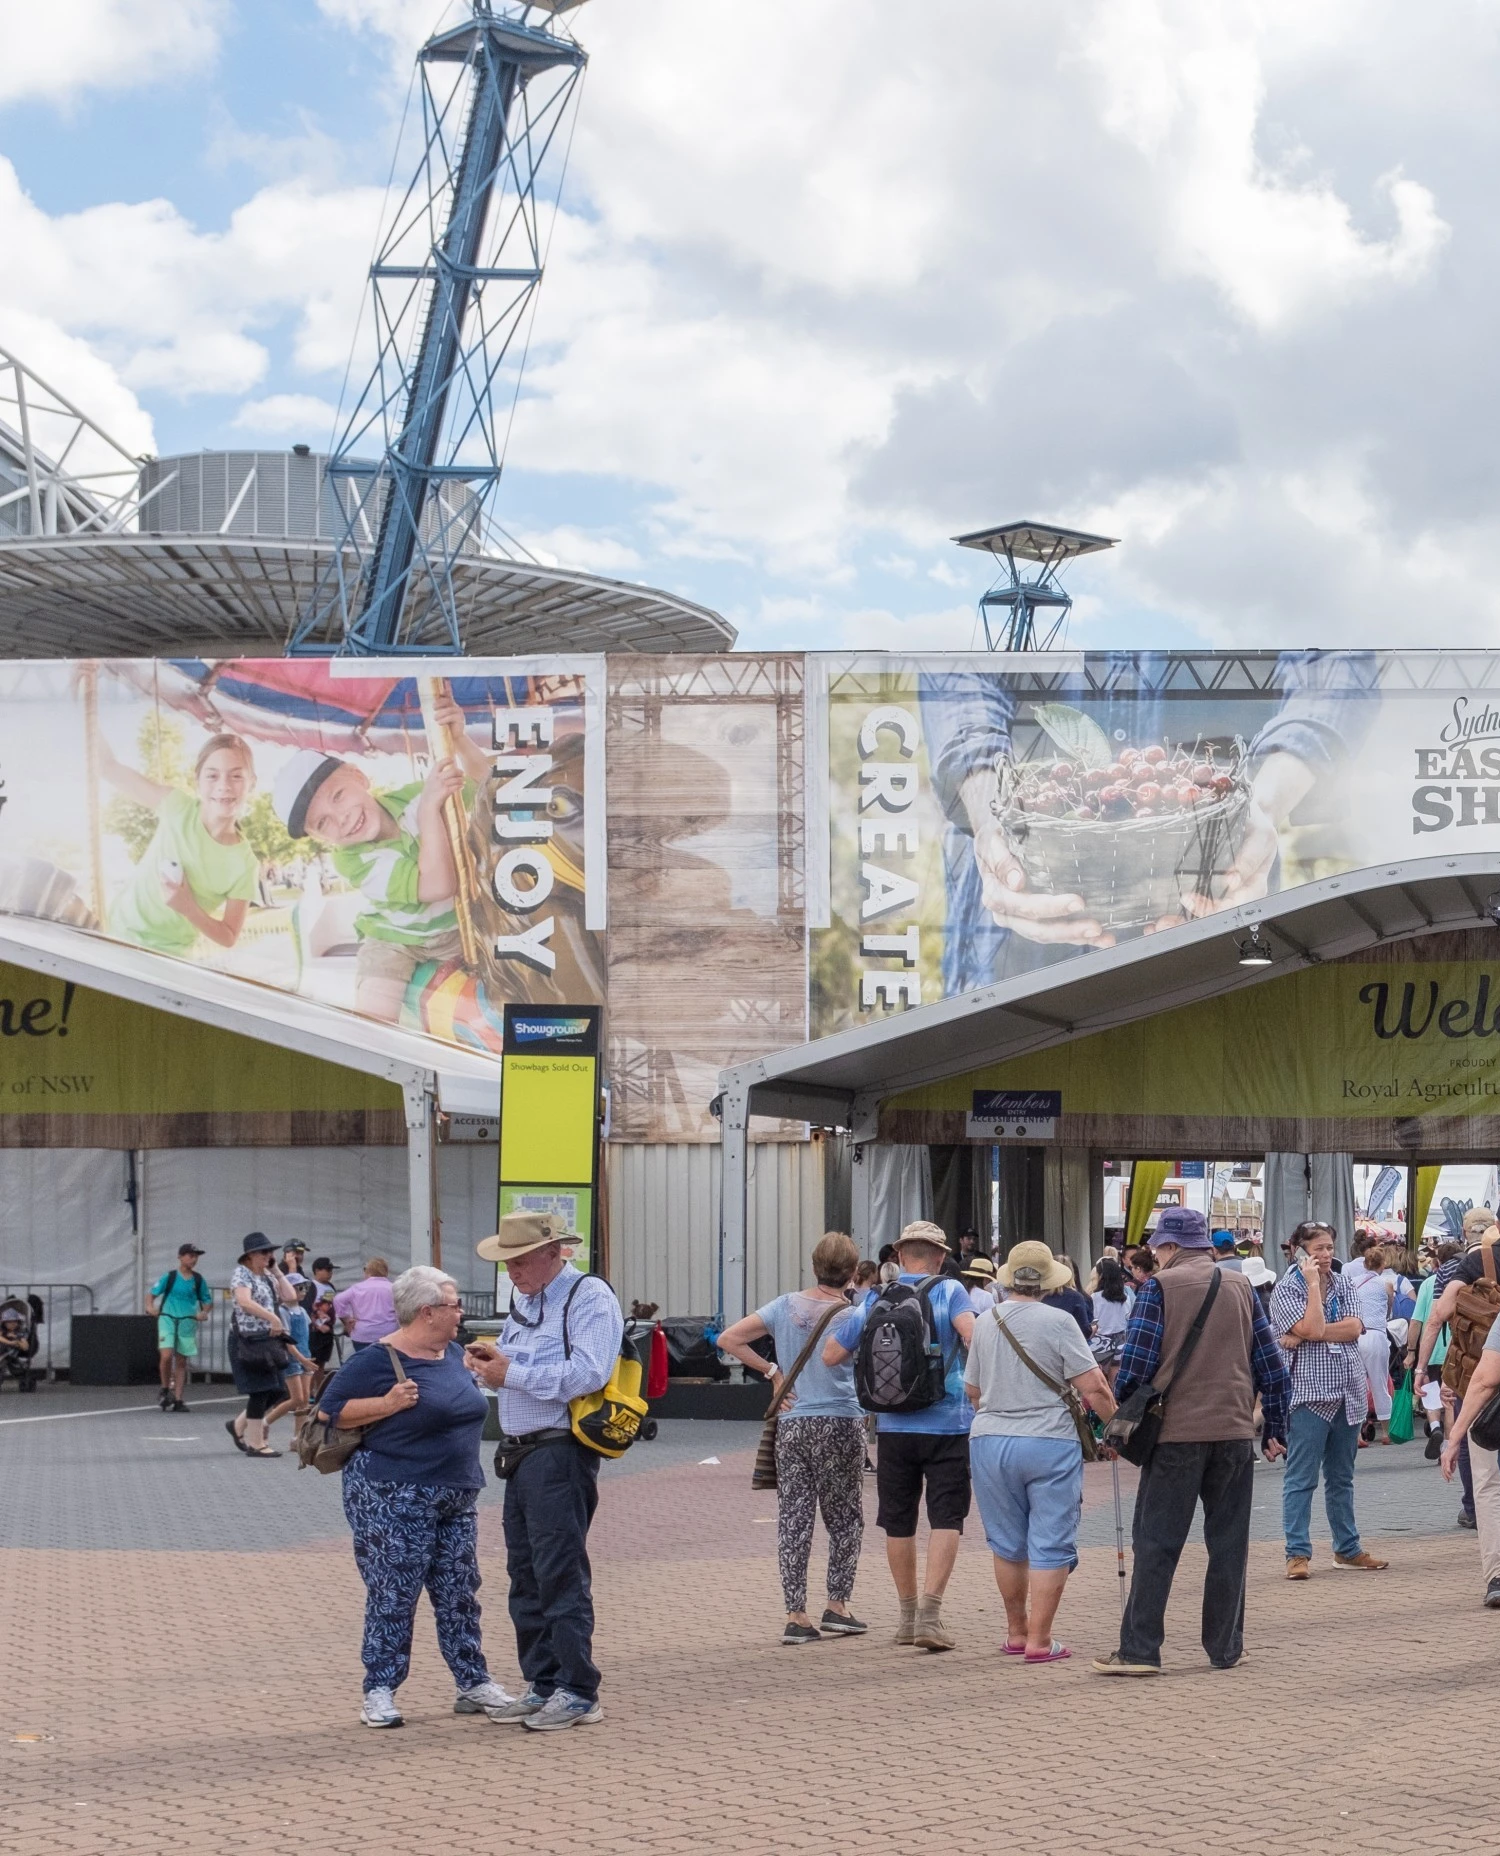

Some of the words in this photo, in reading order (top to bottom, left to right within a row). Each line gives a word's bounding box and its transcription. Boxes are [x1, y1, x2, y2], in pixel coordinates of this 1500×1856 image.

[493, 708, 556, 976] ENJOY
[857, 705, 921, 1011] CREATE
[515, 1023, 586, 1037] Showground
[510, 1062, 550, 1073] Showbags
[552, 1063, 569, 1072] Sold
[572, 1064, 588, 1072] Out
[1450, 1059, 1497, 1068] PROUDLY
[12, 1075, 36, 1094] of
[40, 1075, 95, 1094] NSW
[1342, 1079, 1399, 1103] Royal
[983, 1092, 1052, 1109] Members
[454, 1117, 499, 1126] ACCESSIBL
[1023, 1116, 1051, 1124] ENTRY
